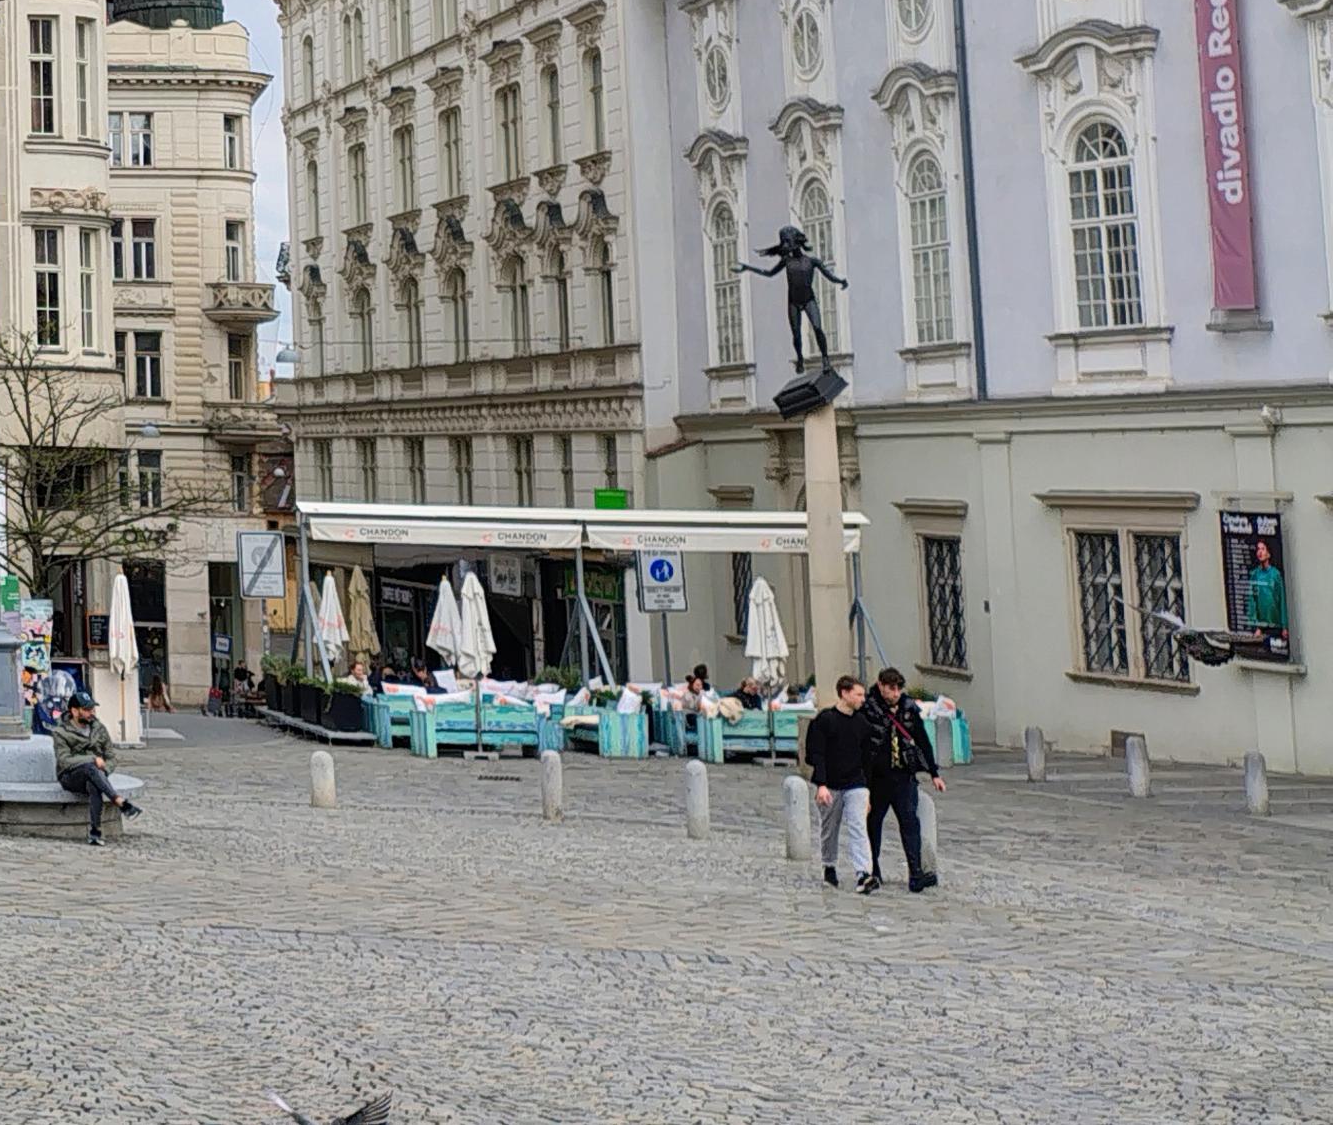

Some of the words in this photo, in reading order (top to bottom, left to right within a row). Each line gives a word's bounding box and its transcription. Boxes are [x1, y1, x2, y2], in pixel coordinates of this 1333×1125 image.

[1210, 66, 1244, 205] divadlo
[359, 527, 409, 537] CHANDON
[497, 531, 547, 542] CHANDON
[637, 535, 686, 544] CHANDON
[775, 537, 807, 546] CHAN
